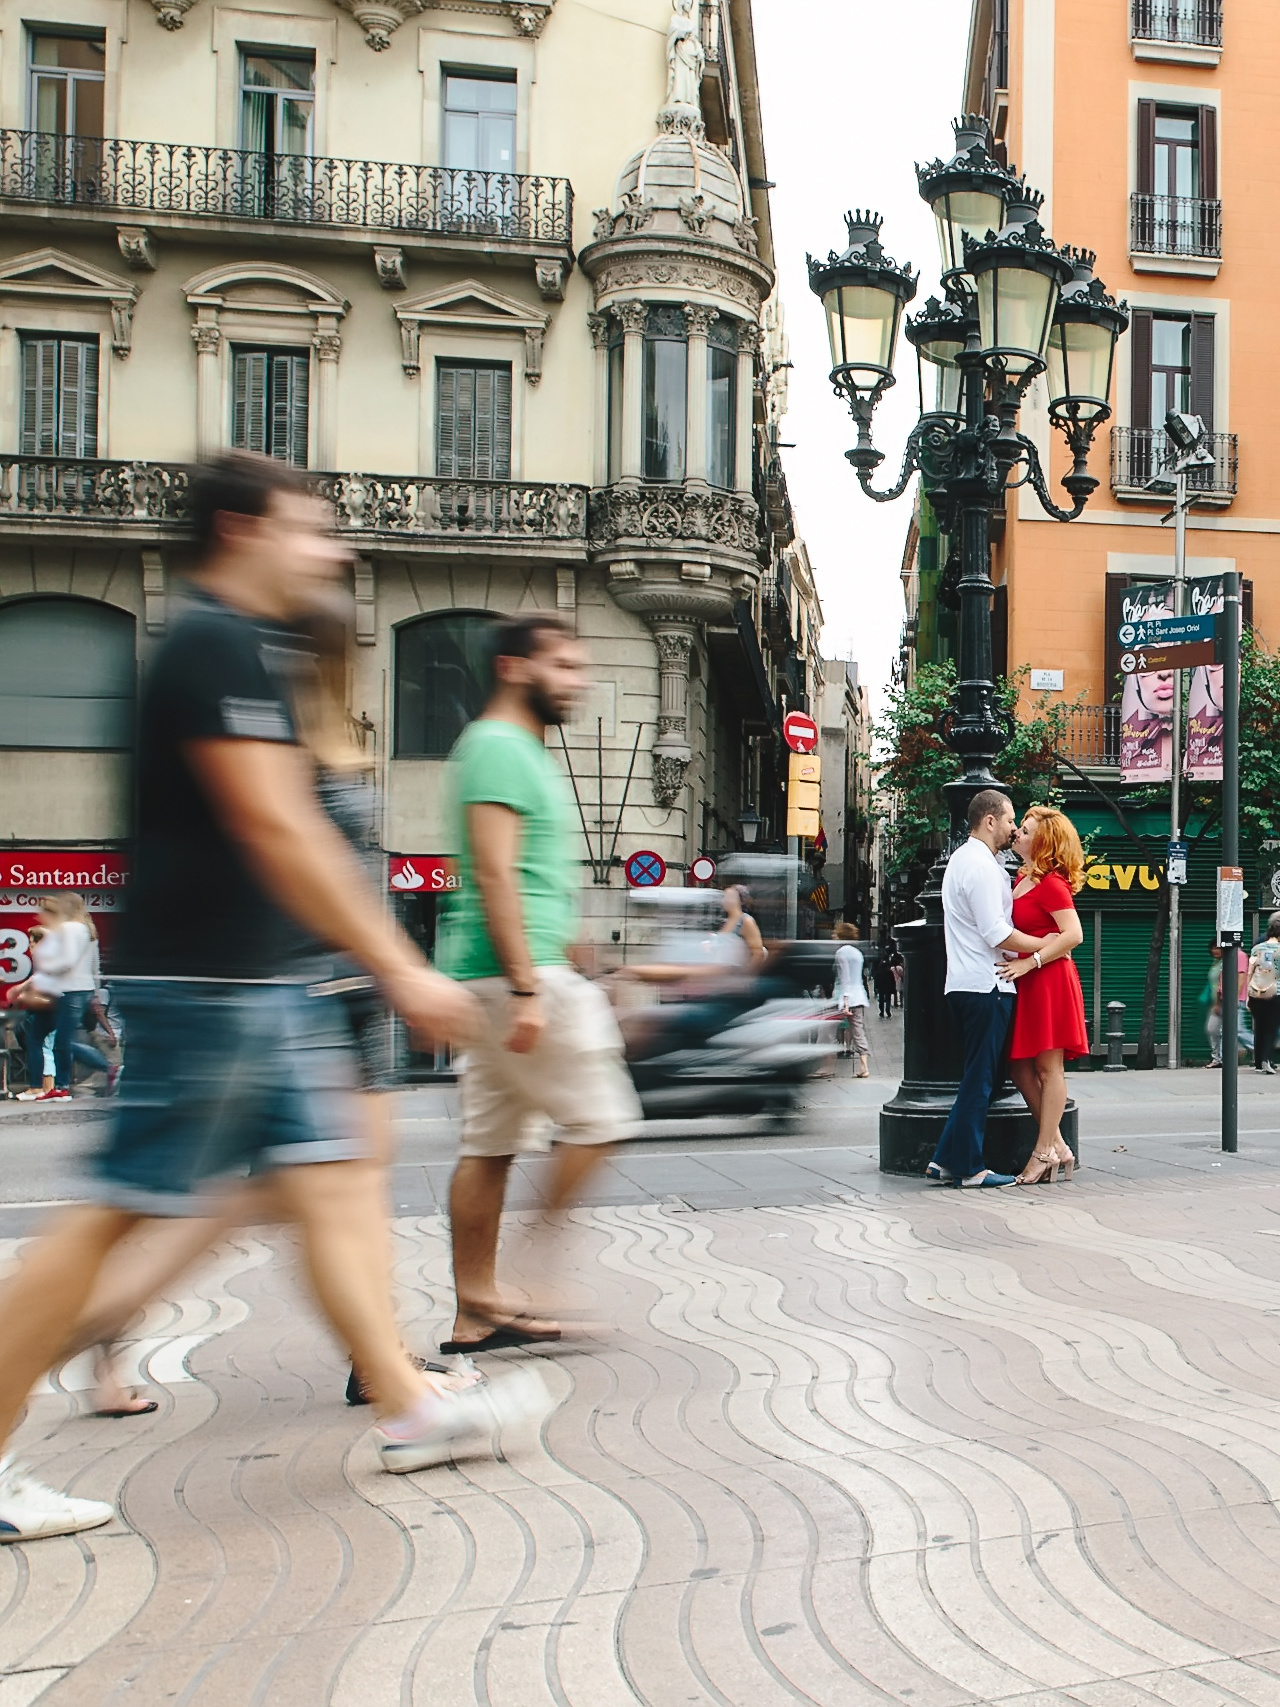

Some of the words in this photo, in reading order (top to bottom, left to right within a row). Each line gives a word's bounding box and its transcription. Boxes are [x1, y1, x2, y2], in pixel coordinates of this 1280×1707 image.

[1155, 627, 1168, 635] Sant
[1186, 624, 1200, 633] Oriol
[10, 864, 130, 886] Santander
